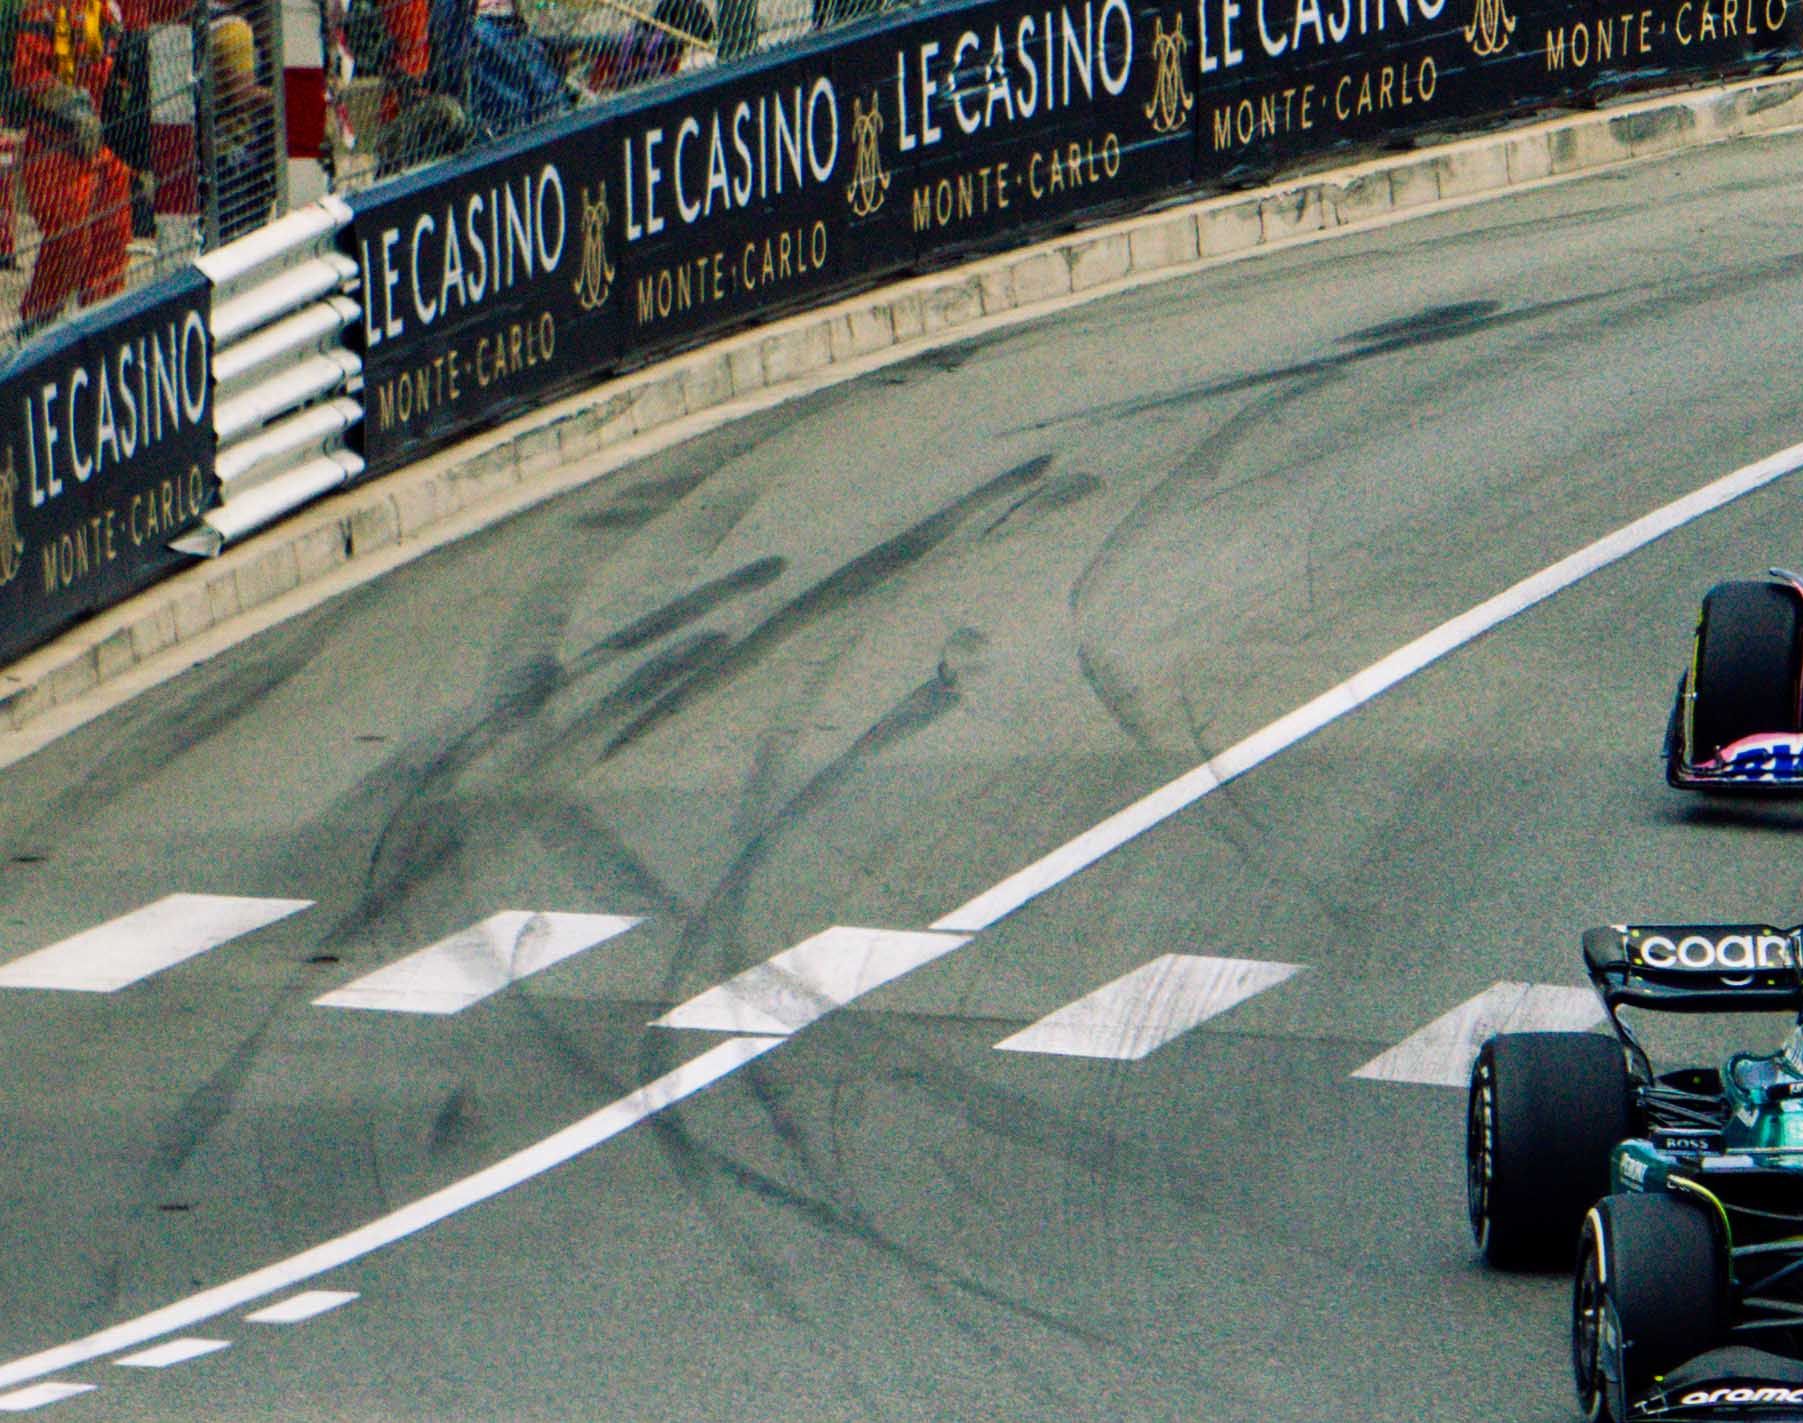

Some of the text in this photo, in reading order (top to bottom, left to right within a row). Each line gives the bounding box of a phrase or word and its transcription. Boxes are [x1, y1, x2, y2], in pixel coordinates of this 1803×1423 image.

[898, 42, 942, 151] LE
[948, 0, 1133, 135] CASINO
[623, 76, 840, 242] LE CASINO
[361, 164, 567, 348] LE CASINO
[27, 310, 208, 508] LE CASINO
[1666, 1137, 1709, 1150] BOSS
